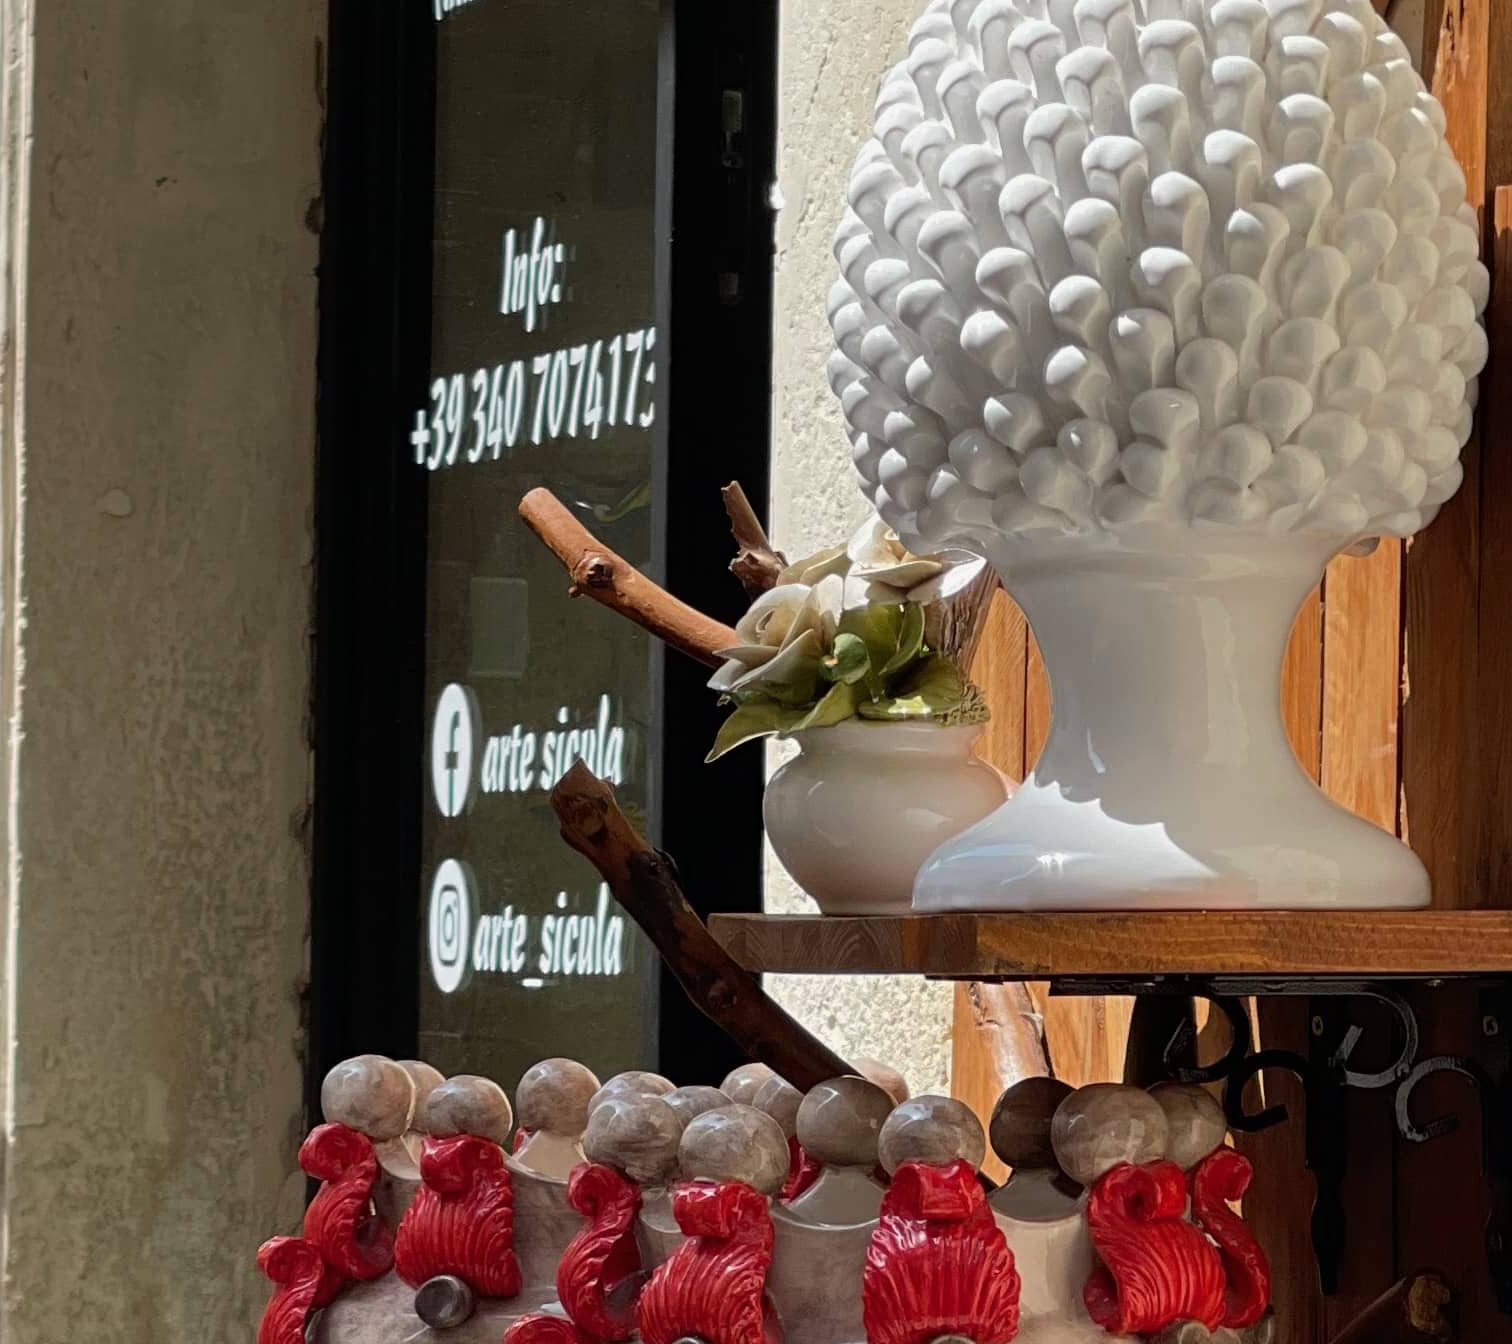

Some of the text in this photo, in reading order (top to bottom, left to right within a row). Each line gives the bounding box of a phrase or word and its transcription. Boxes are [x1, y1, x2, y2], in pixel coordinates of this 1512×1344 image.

[500, 216, 563, 332] Info:
[410, 374, 464, 470] +39
[468, 360, 524, 463] 340
[482, 694, 624, 792] arte sicula
[473, 883, 622, 988] arte_sicula
